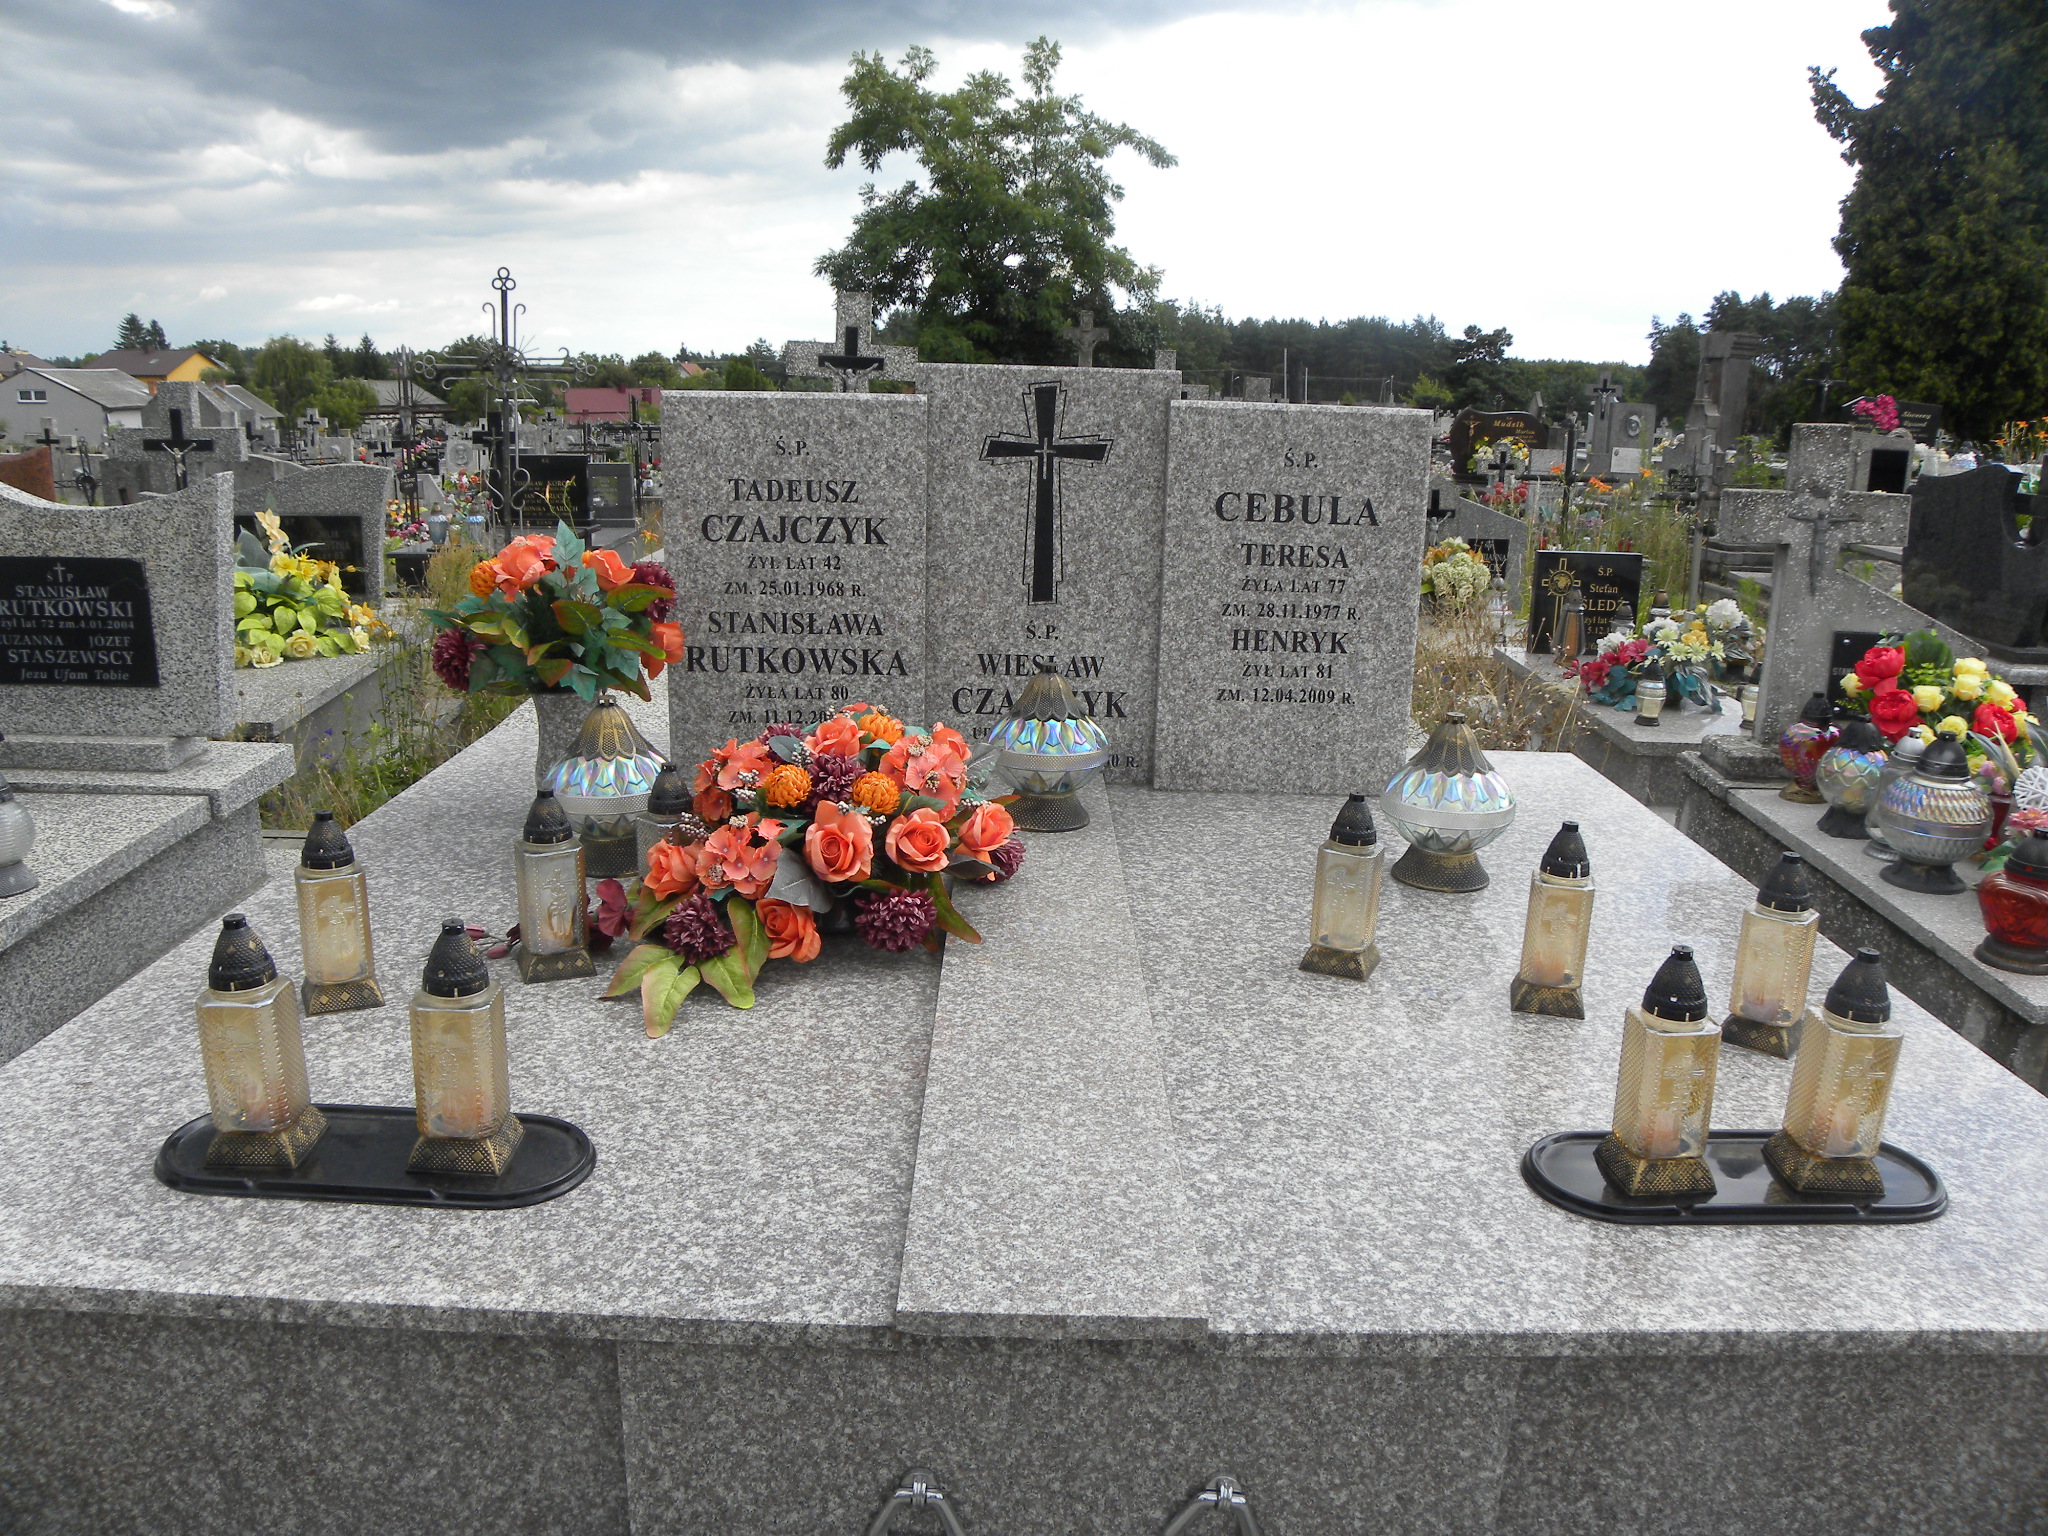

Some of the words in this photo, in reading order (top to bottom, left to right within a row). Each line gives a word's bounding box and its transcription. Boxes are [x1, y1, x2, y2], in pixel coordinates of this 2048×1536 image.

[729, 478, 859, 503] TADEUSZ
[1215, 491, 1379, 527] CEBULA
[701, 515, 888, 545] CZAJCZYK
[786, 556, 816, 570] LAT
[823, 555, 841, 570] 42
[1241, 543, 1349, 569] TERESA
[724, 582, 753, 595] ZM.
[760, 581, 844, 597] 25.01.1968
[852, 584, 866, 597] R.
[1241, 575, 1283, 592] ŻYŁA
[1290, 580, 1321, 593] LAT
[1328, 579, 1346, 594] 77
[1589, 583, 1618, 594] Stefan
[0, 600, 134, 617] RUTKOWSKI
[1221, 603, 1250, 617] ZM.
[1257, 603, 1341, 620] 28.11.1977
[1347, 607, 1361, 620] R.
[21, 618, 37, 628] lat
[41, 619, 55, 628] 72
[708, 611, 883, 636] STANISŁAWA
[89, 633, 131, 648] JÓZEF
[1231, 629, 1349, 654] HENRYK
[8, 648, 134, 665] STASZEWSCY
[686, 645, 908, 676] RUTKOWSKA
[20, 668, 48, 681] Jezu
[54, 669, 88, 682] Ufam
[95, 669, 129, 681] Tobie
[1280, 666, 1309, 678] LAT
[1316, 664, 1333, 679] 81
[795, 687, 825, 700] LAT
[831, 685, 848, 701] 80
[1216, 688, 1245, 702] ZM.
[1253, 688, 1335, 703] 12.04.2009
[1342, 692, 1355, 704] R.
[728, 710, 756, 723] ZM.
